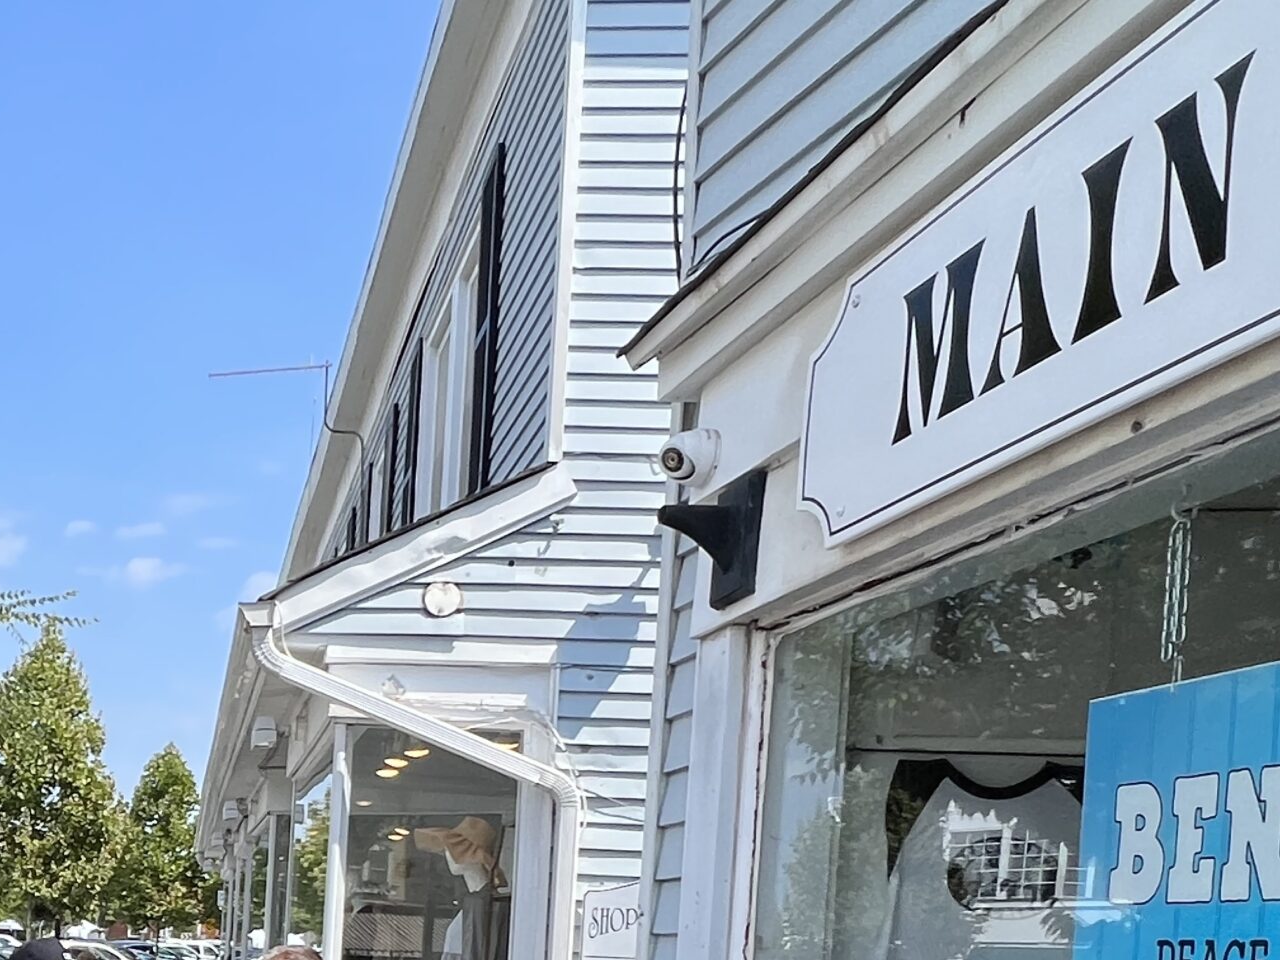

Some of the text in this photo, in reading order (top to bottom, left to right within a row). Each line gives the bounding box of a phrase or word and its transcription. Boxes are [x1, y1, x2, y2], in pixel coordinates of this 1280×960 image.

[892, 49, 1256, 446] MAIN
[1108, 764, 1280, 905] BEN
[588, 907, 639, 939] SHOP
